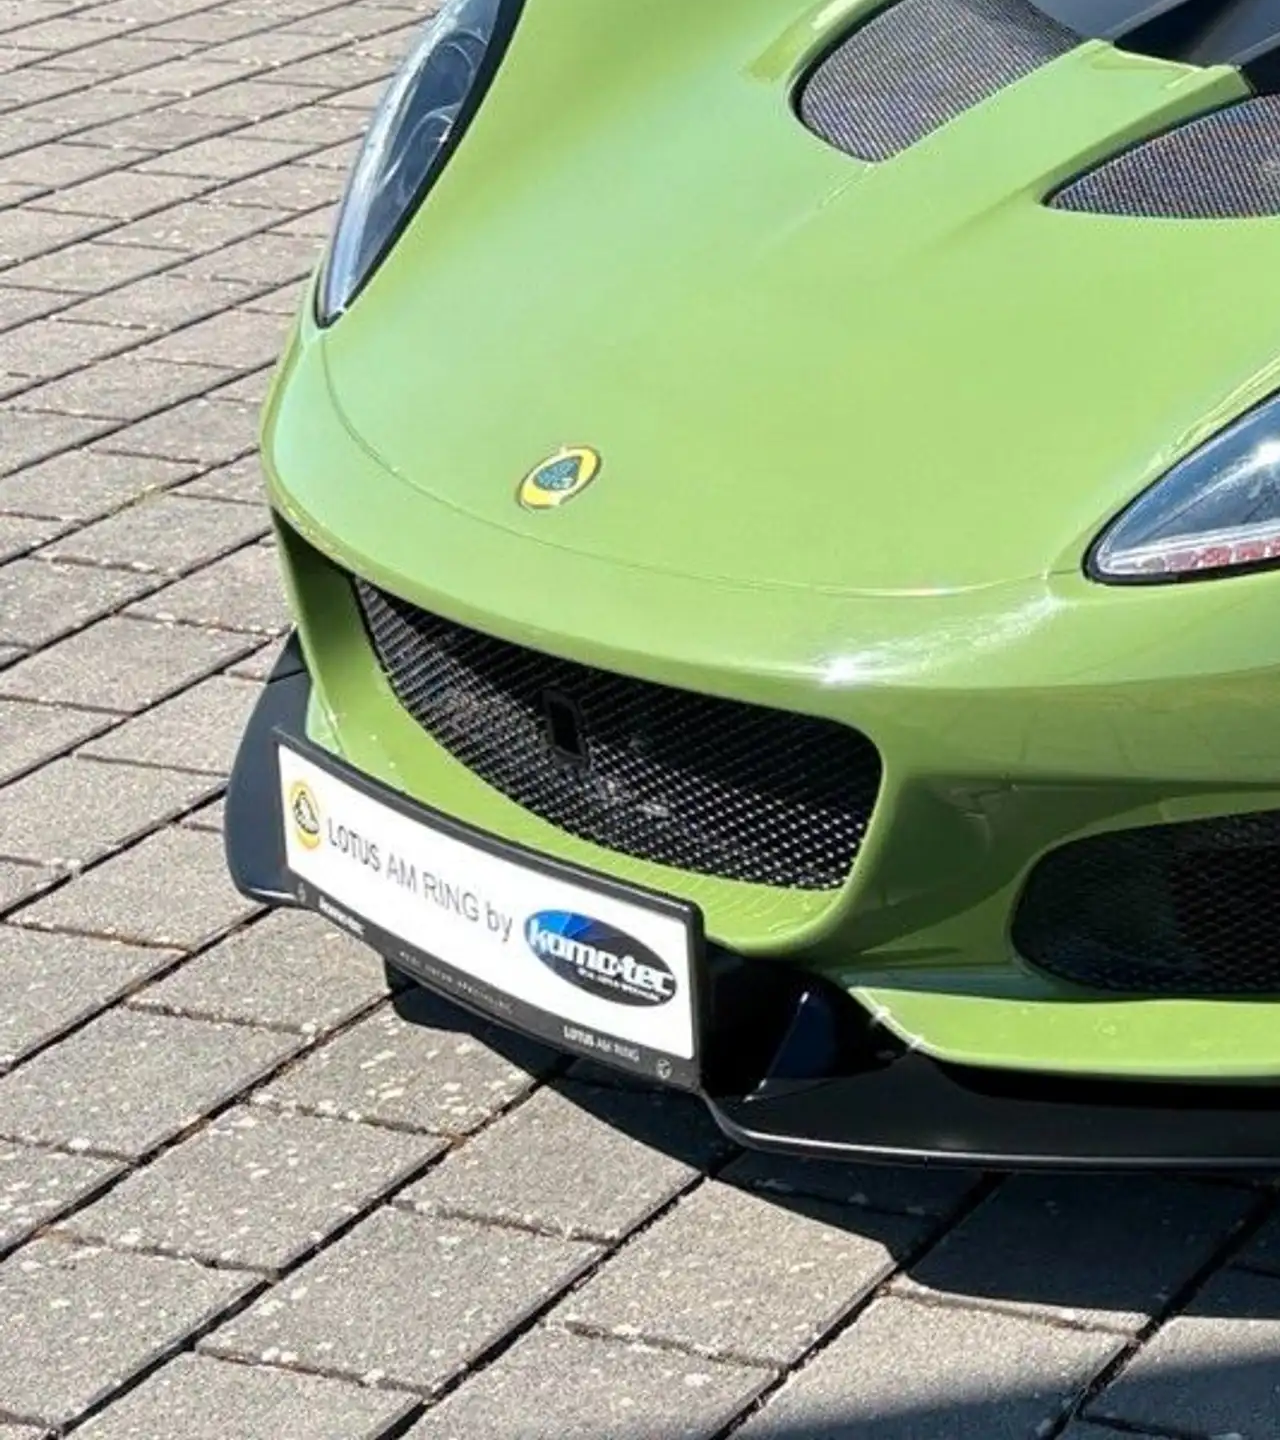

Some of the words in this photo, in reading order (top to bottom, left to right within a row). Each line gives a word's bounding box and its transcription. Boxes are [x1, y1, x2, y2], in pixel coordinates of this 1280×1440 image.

[327, 816, 381, 872] LOTUS
[386, 852, 418, 894] AM
[422, 871, 480, 923] RING
[485, 900, 513, 943] by
